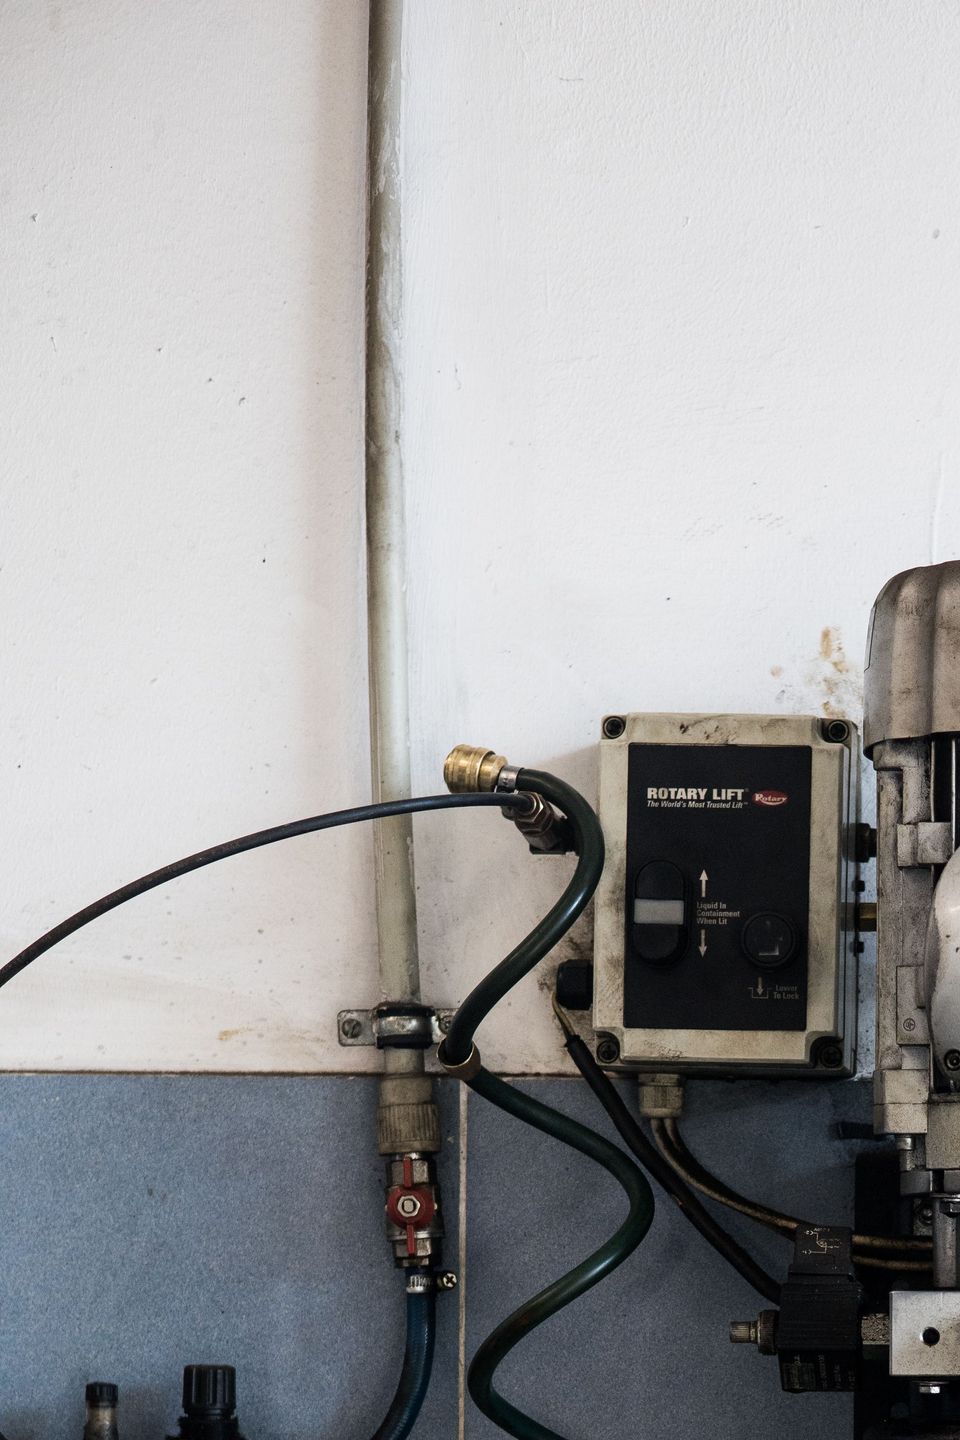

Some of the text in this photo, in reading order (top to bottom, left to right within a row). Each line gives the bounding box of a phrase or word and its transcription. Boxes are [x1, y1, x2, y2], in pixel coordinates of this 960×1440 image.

[646, 787, 708, 800] ROTARY
[754, 793, 787, 805] Rotary
[647, 800, 659, 808] The
[660, 800, 687, 808] World's
[696, 902, 718, 910] Liquid
[696, 909, 740, 918] Containment
